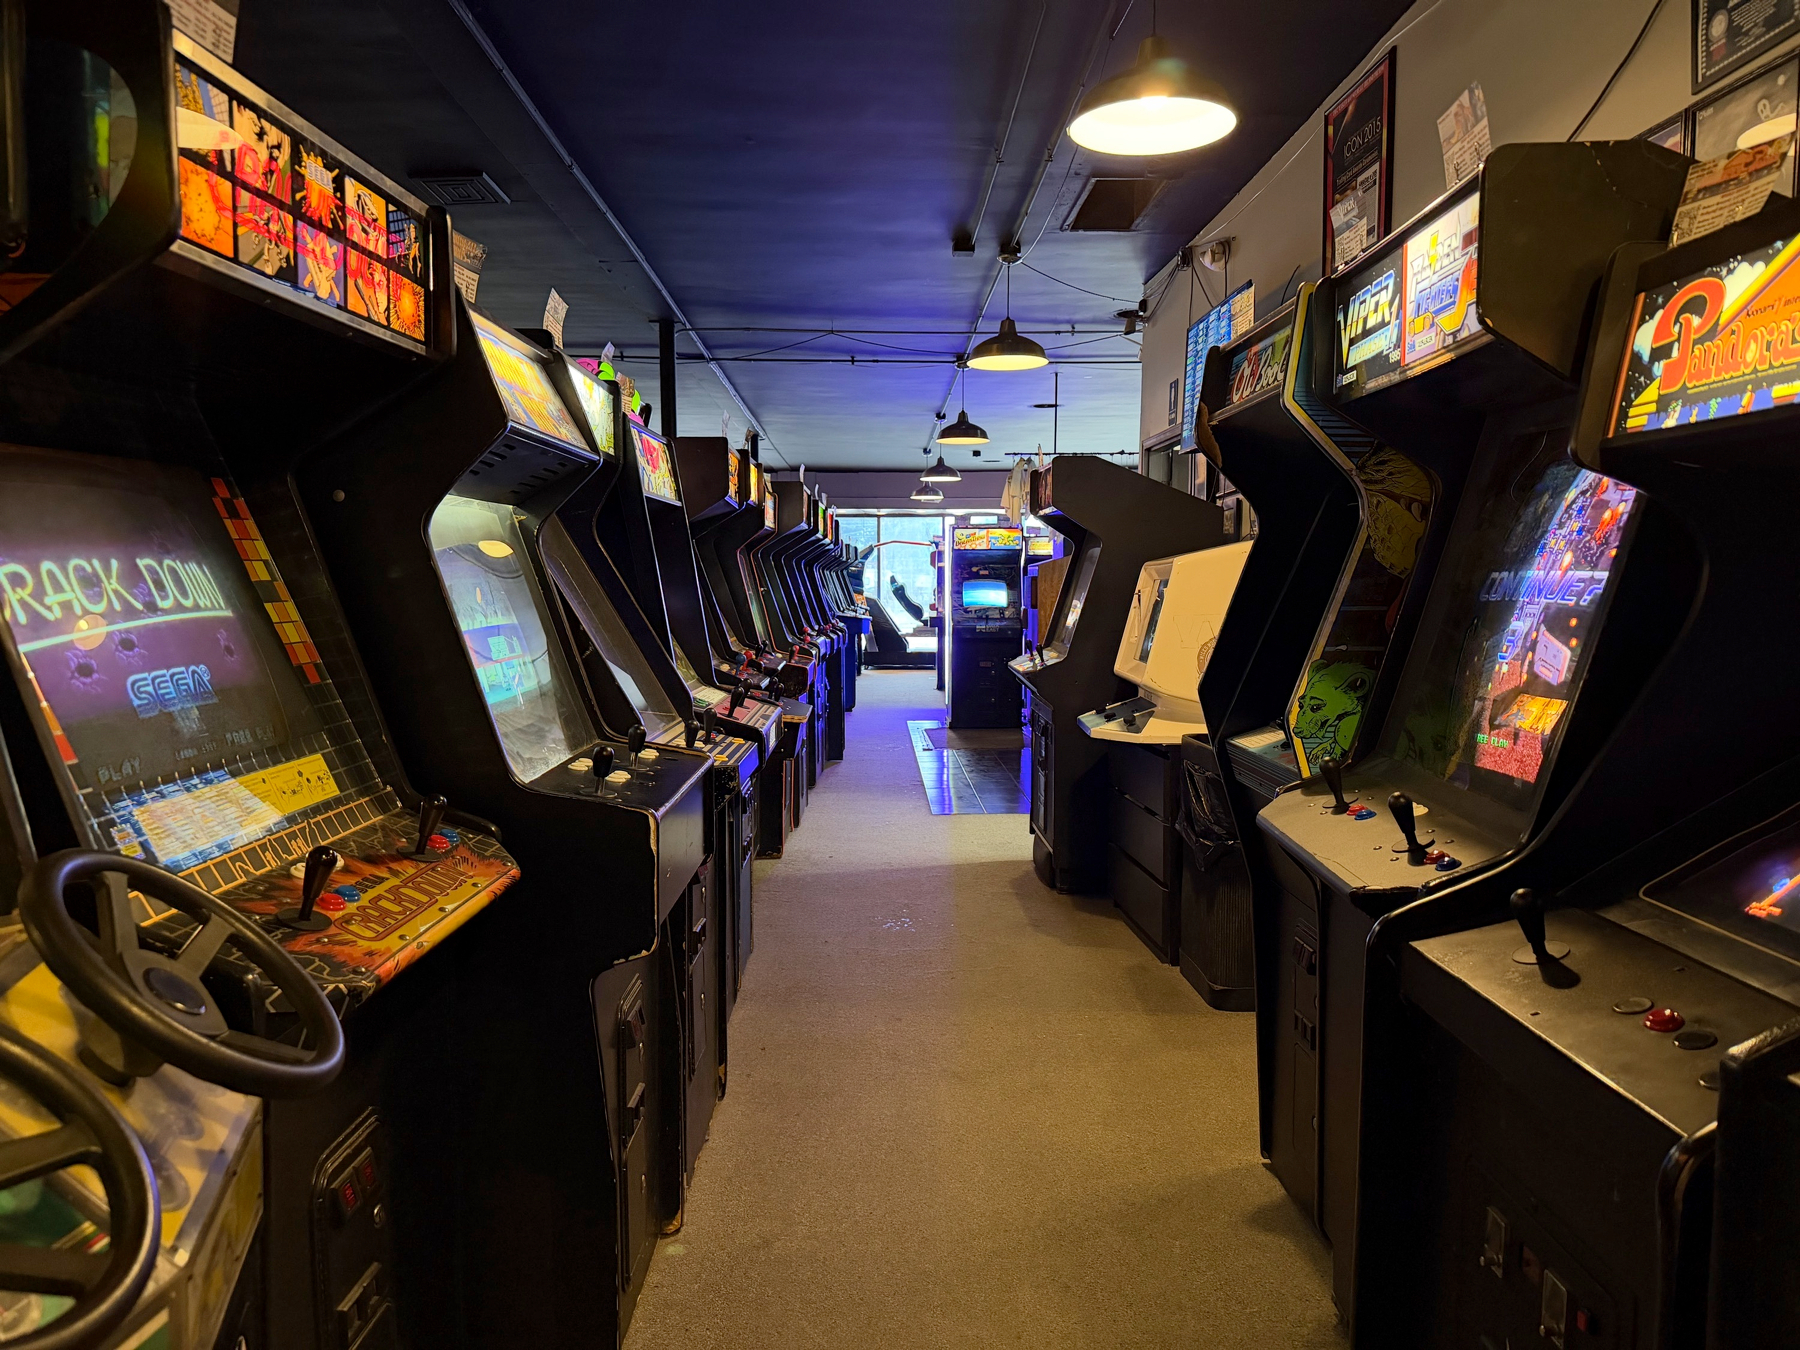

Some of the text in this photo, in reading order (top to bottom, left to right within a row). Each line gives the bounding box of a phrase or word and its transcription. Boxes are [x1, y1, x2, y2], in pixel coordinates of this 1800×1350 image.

[1364, 116, 1381, 143] 2015
[306, 159, 334, 197] SEGA
[1337, 269, 1395, 369] VIPER
[0, 558, 226, 625] RACK DOWN
[1479, 570, 1609, 606] CONTINUE?
[1498, 621, 1524, 662] 3
[127, 666, 211, 714] SEGA
[1491, 736, 1509, 748] PLAY
[98, 756, 142, 785] PLAY
